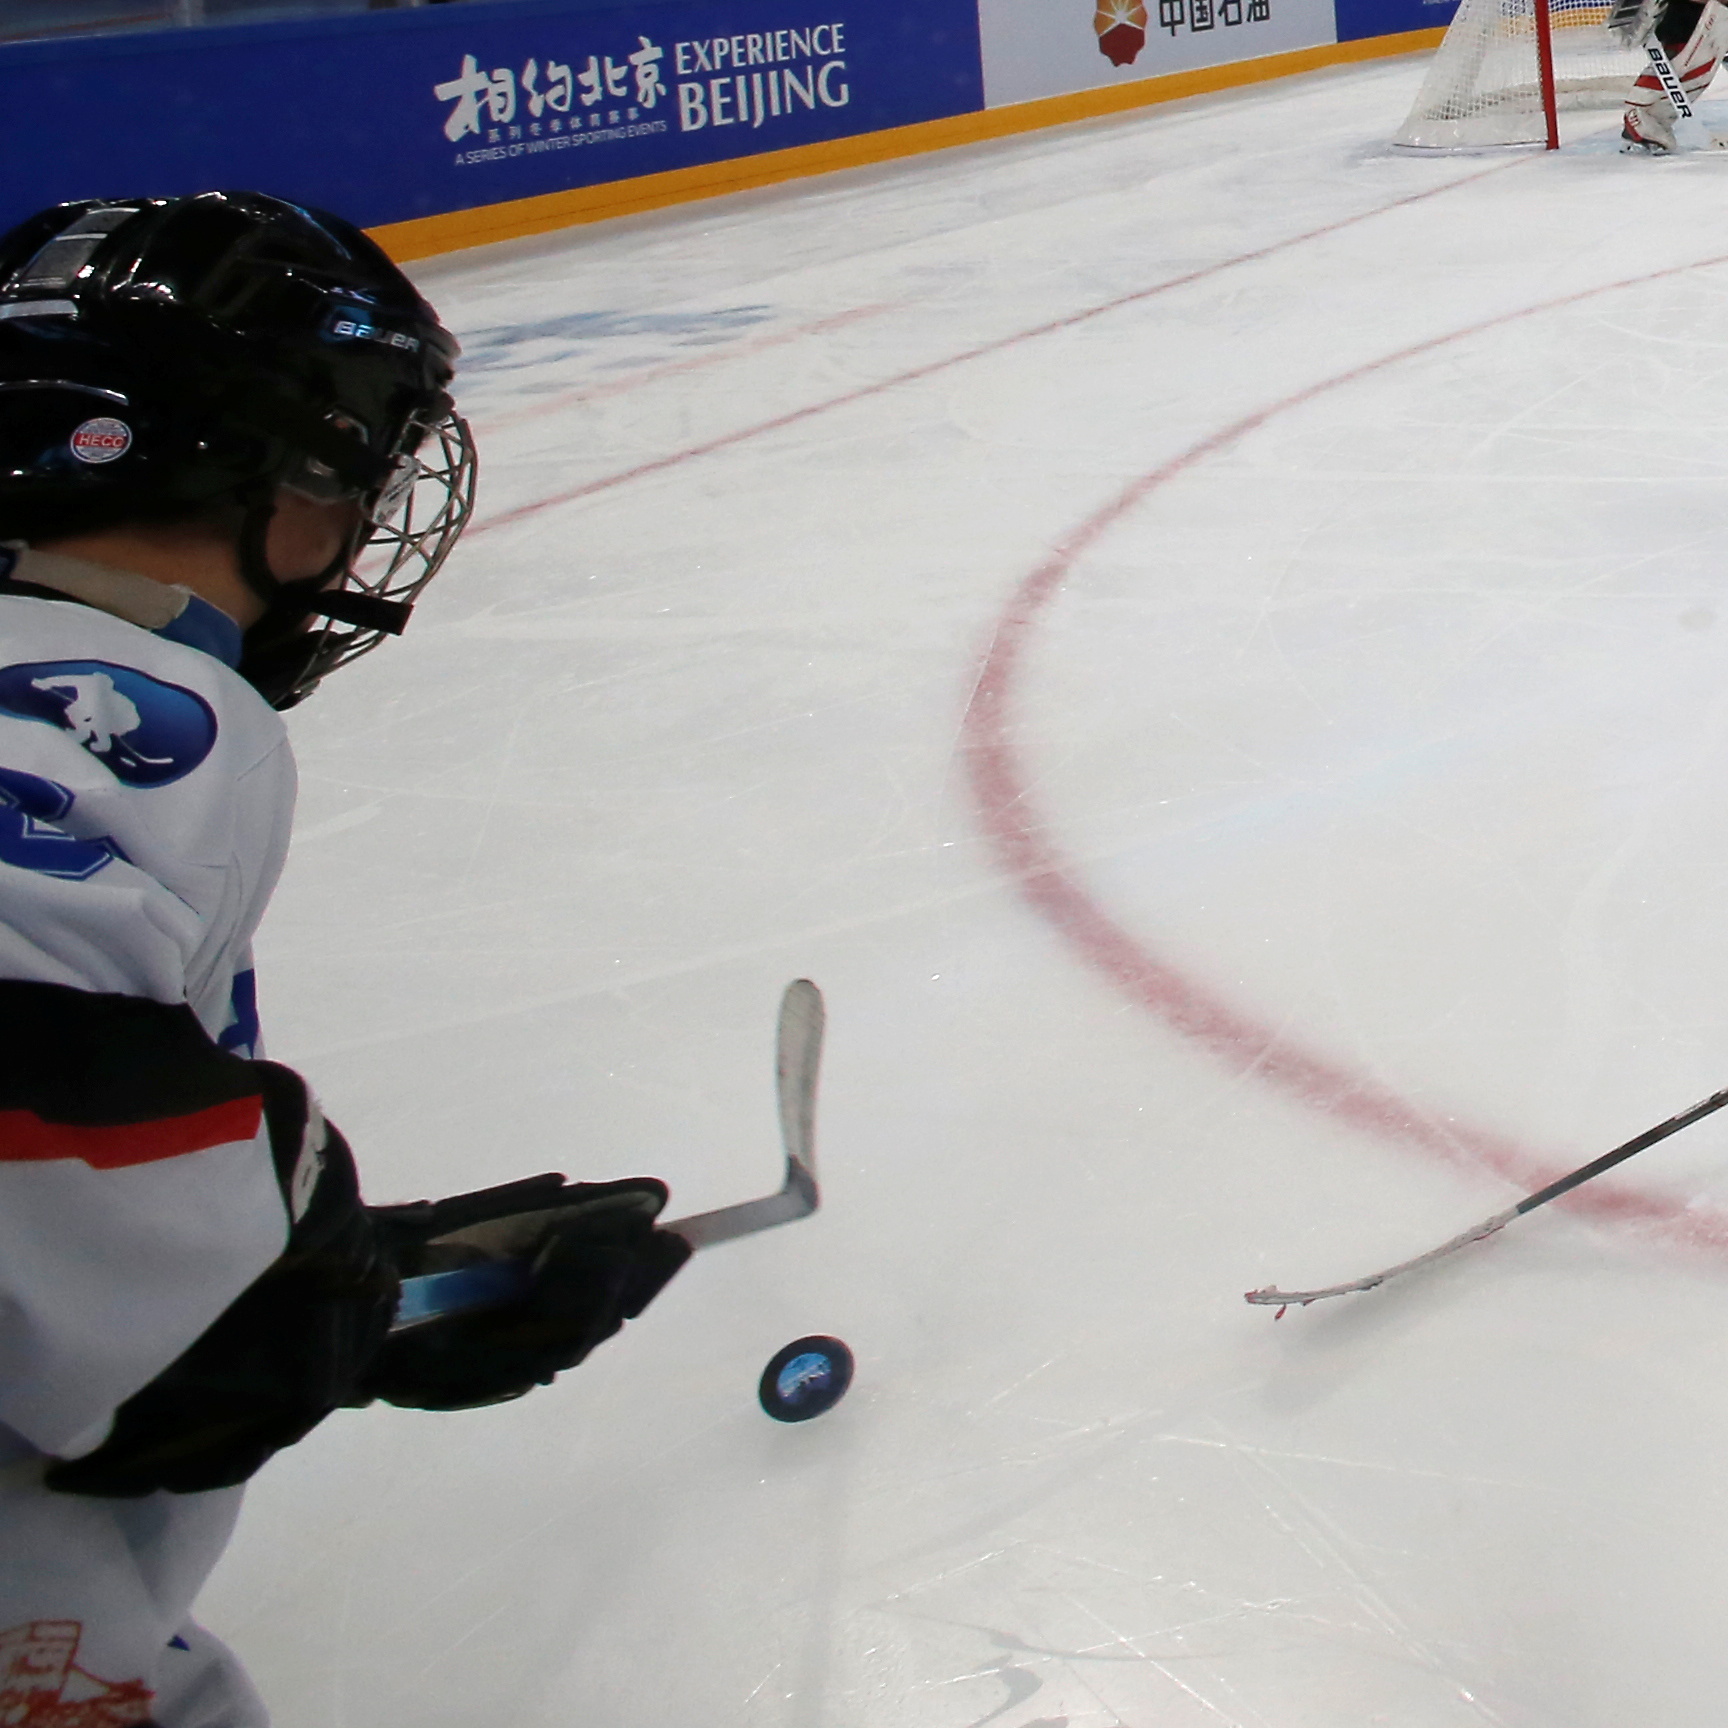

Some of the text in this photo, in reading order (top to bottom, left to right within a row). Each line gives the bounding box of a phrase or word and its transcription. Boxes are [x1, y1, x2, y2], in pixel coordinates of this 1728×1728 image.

[675, 23, 846, 75] EXPERIENCE
[434, 35, 667, 142] 相约北京
[677, 60, 849, 132] BEIJING
[466, 148, 507, 165] SERIES
[527, 135, 571, 153] WINTER
[572, 128, 626, 147] SPORTING
[627, 121, 668, 138] EVENTS
[79, 433, 124, 449] HECC
